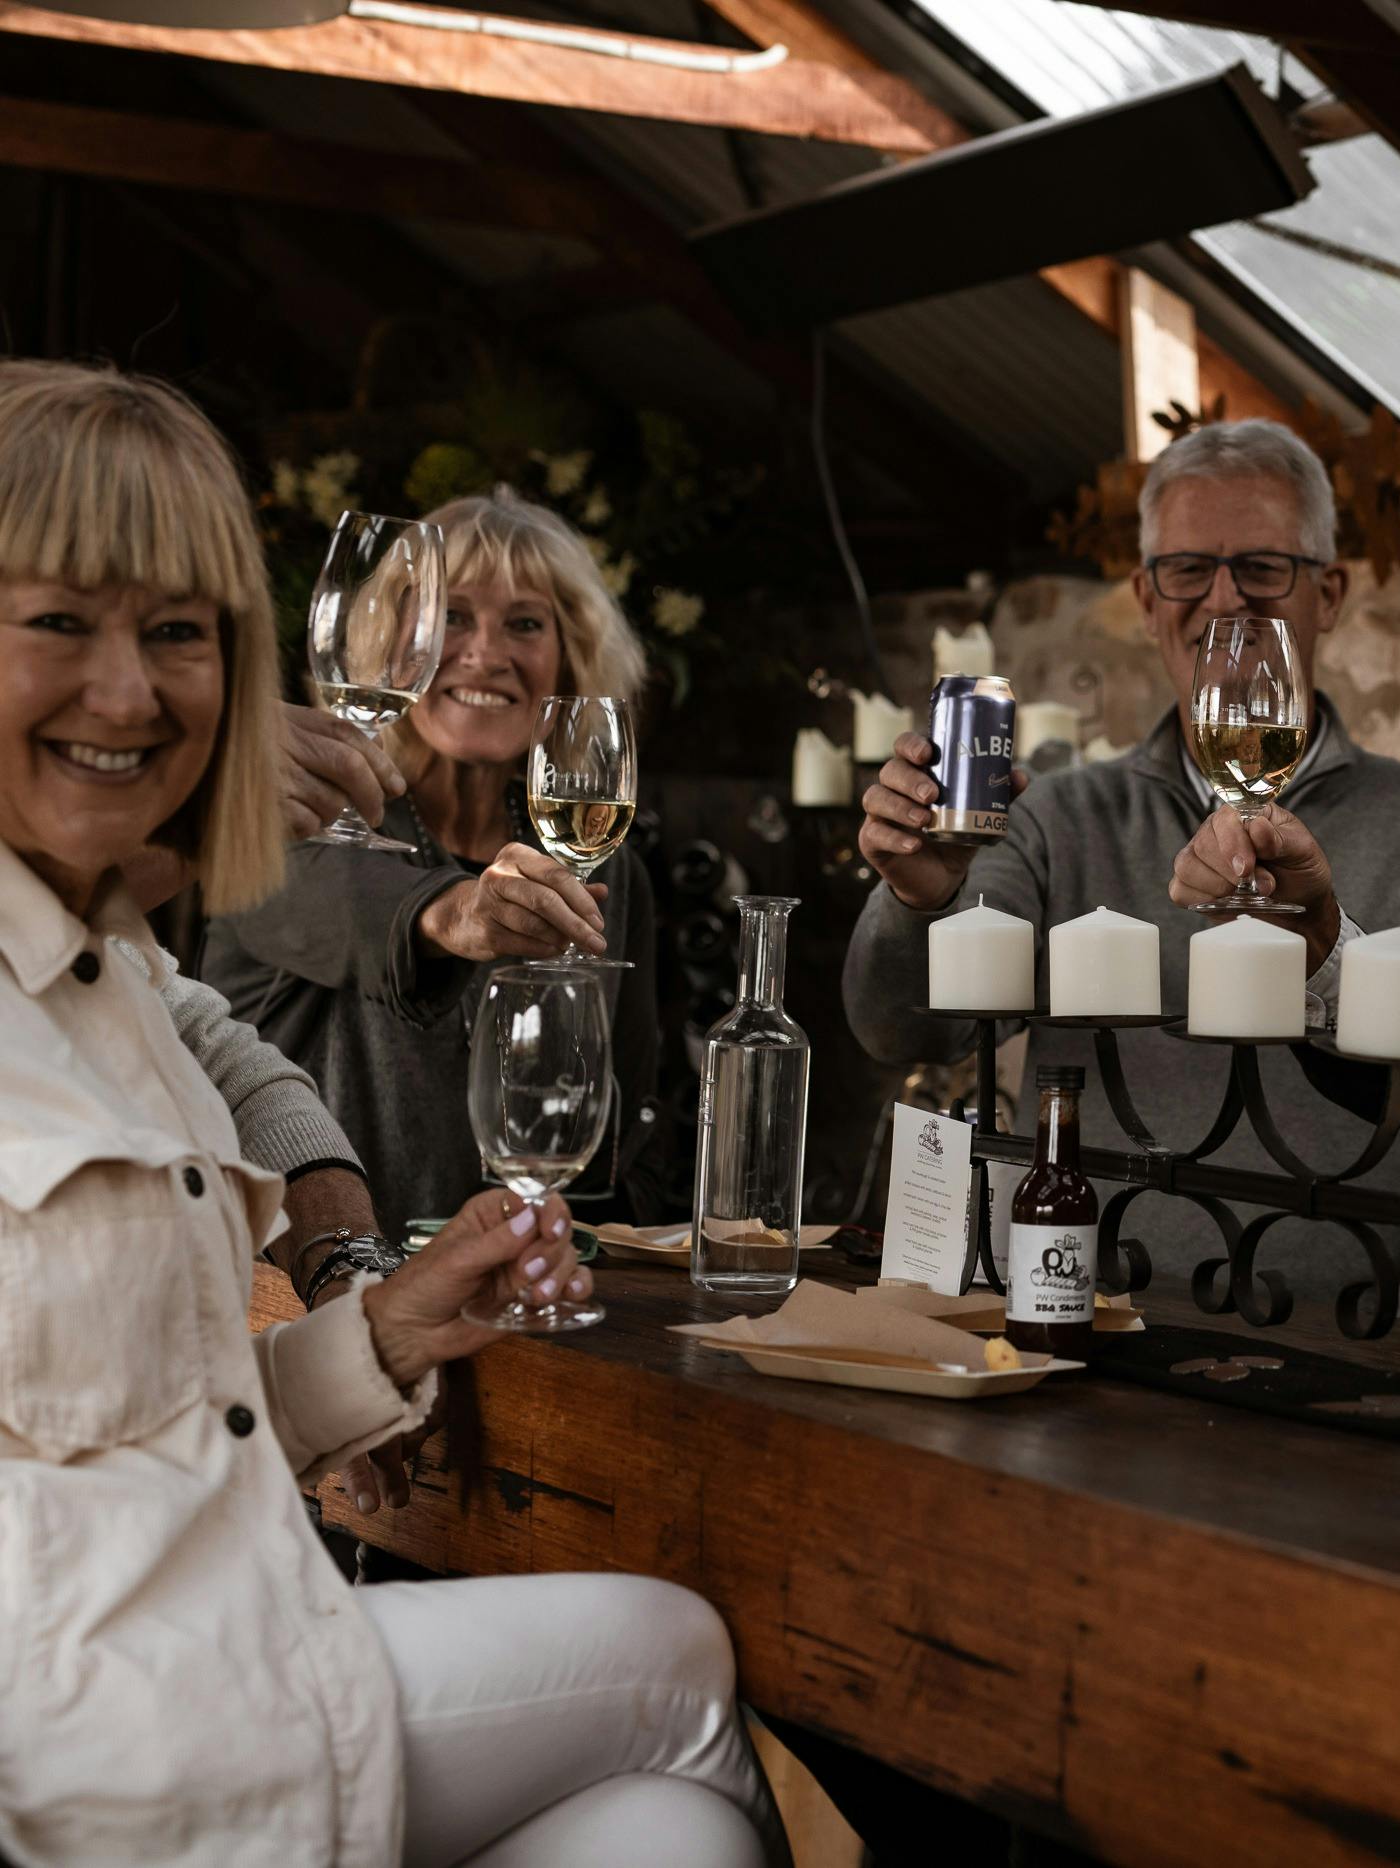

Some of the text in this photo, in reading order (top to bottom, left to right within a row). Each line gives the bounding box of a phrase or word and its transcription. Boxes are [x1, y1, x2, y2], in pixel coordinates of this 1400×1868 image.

[957, 736, 1014, 761] ALBE
[974, 814, 1008, 832] LAGE
[1035, 1302, 1085, 1312] BBQ SAUCE
